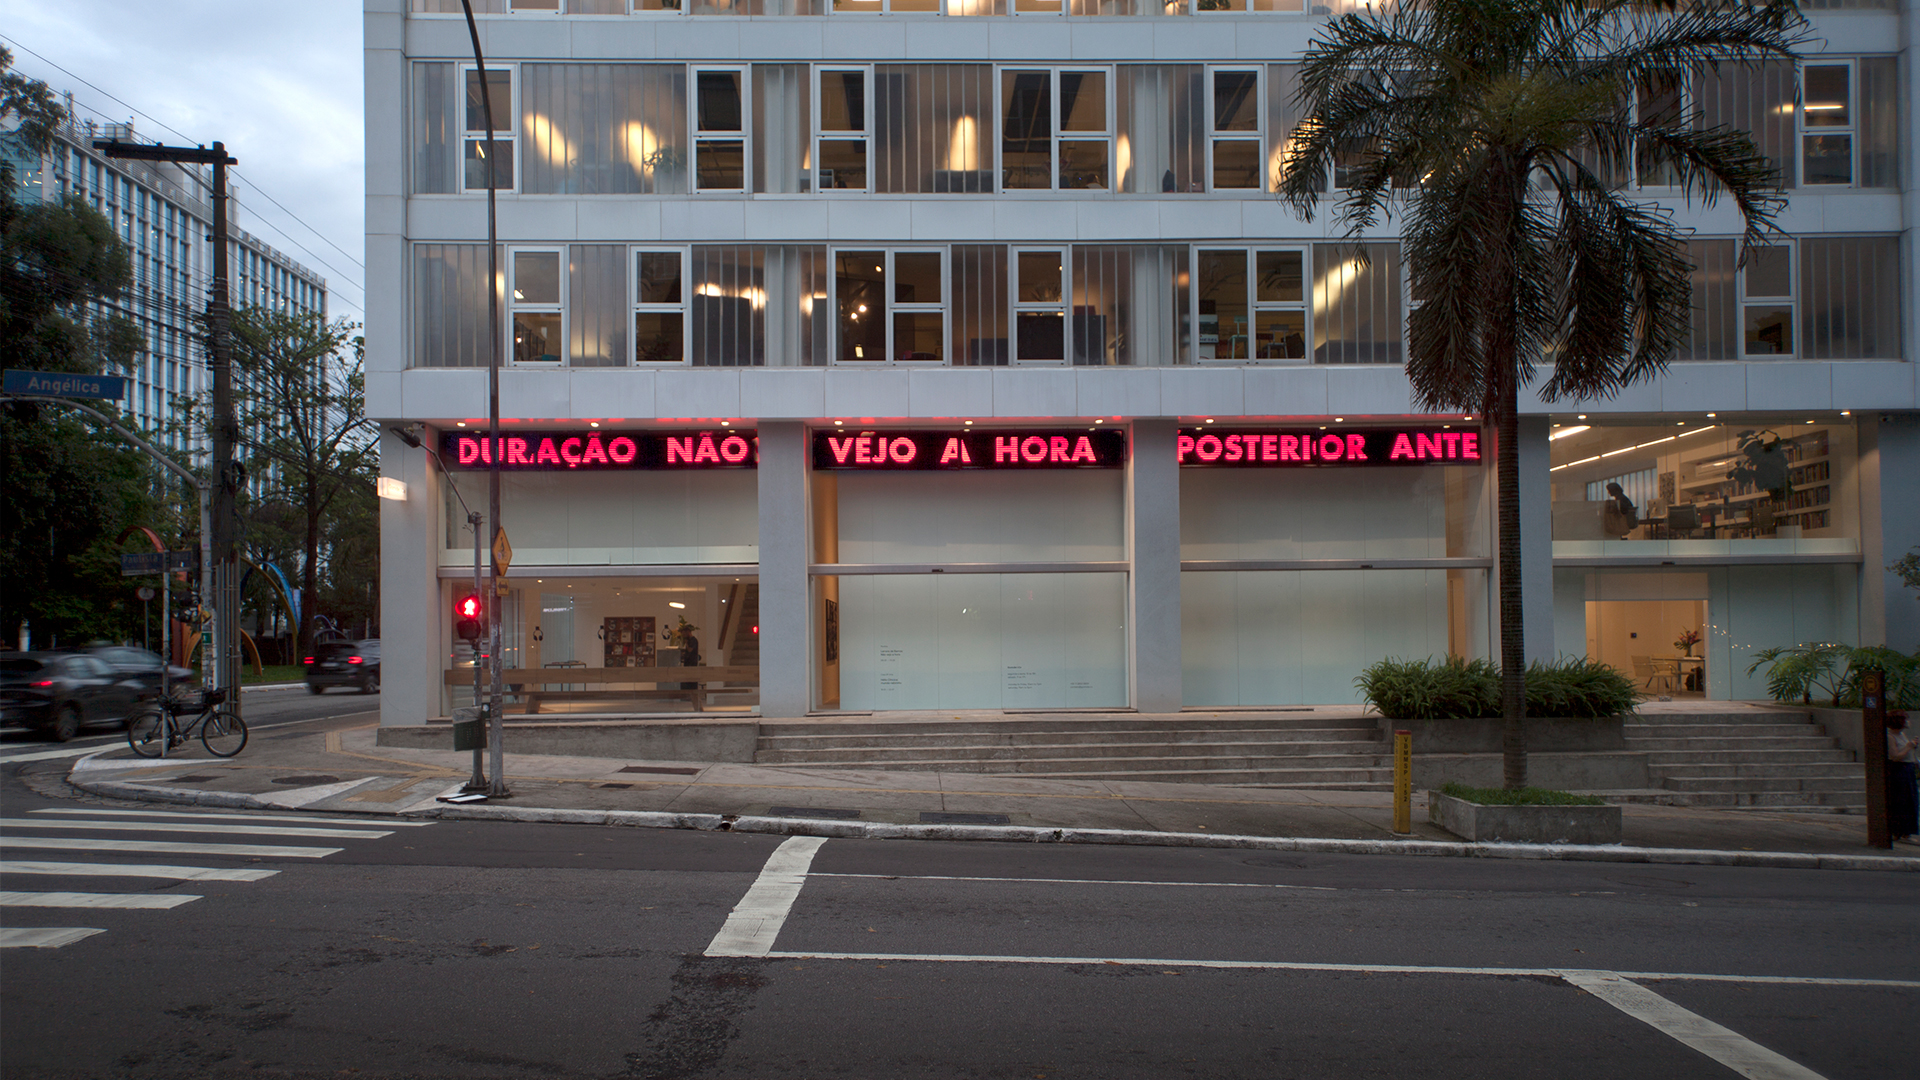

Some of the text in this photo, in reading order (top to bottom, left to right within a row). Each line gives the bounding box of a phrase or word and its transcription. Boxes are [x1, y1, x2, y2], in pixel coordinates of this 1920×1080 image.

[27, 376, 100, 395] Angélica
[458, 431, 748, 467] DURAÇÃO NÃO
[996, 436, 1097, 462] HORA
[1178, 433, 1480, 462] POSTERIOR ANTE
